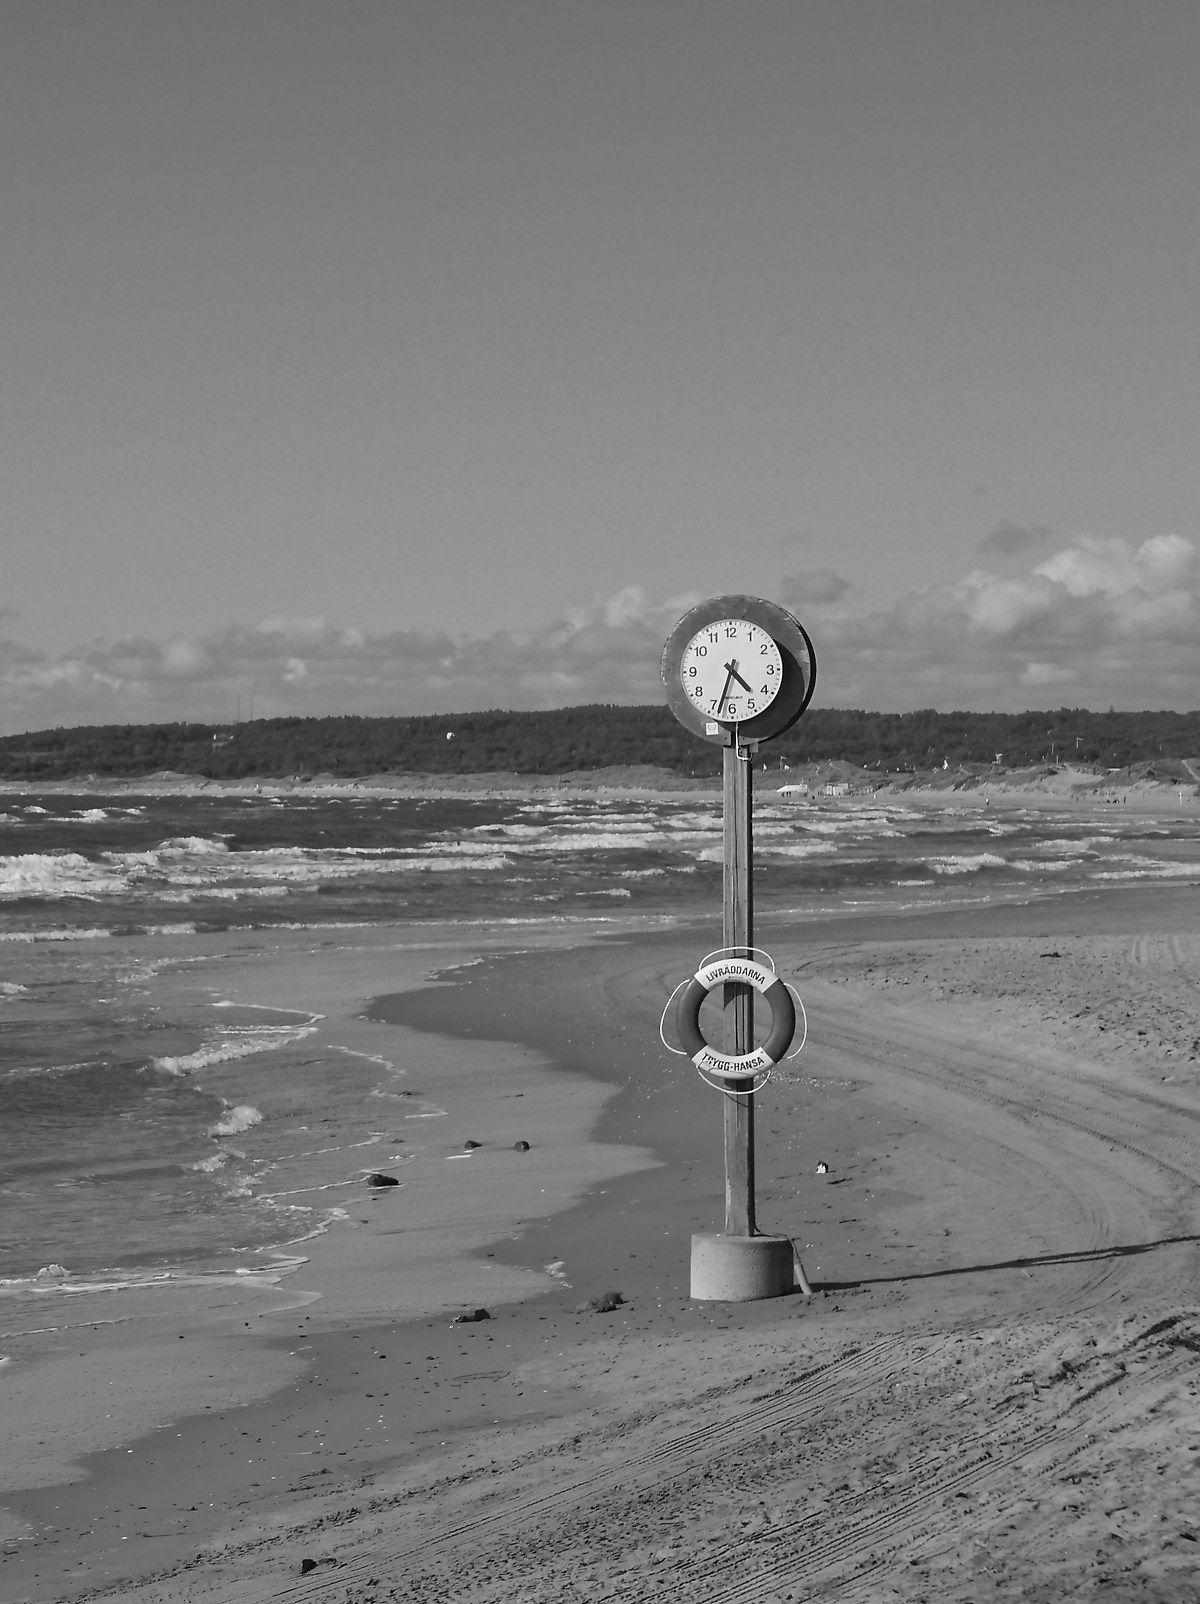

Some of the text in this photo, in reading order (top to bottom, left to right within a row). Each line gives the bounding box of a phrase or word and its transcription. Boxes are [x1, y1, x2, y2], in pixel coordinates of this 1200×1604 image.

[708, 632, 718, 643] 11
[724, 627, 737, 638] 12
[747, 631, 752, 642] 1
[694, 646, 707, 656] 10
[760, 644, 768, 655] 2
[689, 667, 697, 677] 9
[766, 664, 775, 675] 3
[695, 686, 703, 697] 8
[760, 684, 769, 695] 4
[710, 699, 718, 710] 7
[728, 703, 737, 714] 6
[747, 698, 755, 709] 5
[706, 964, 766, 985] LIVRÄDDARNA
[702, 1052, 765, 1072] TRYGG-HANSA
